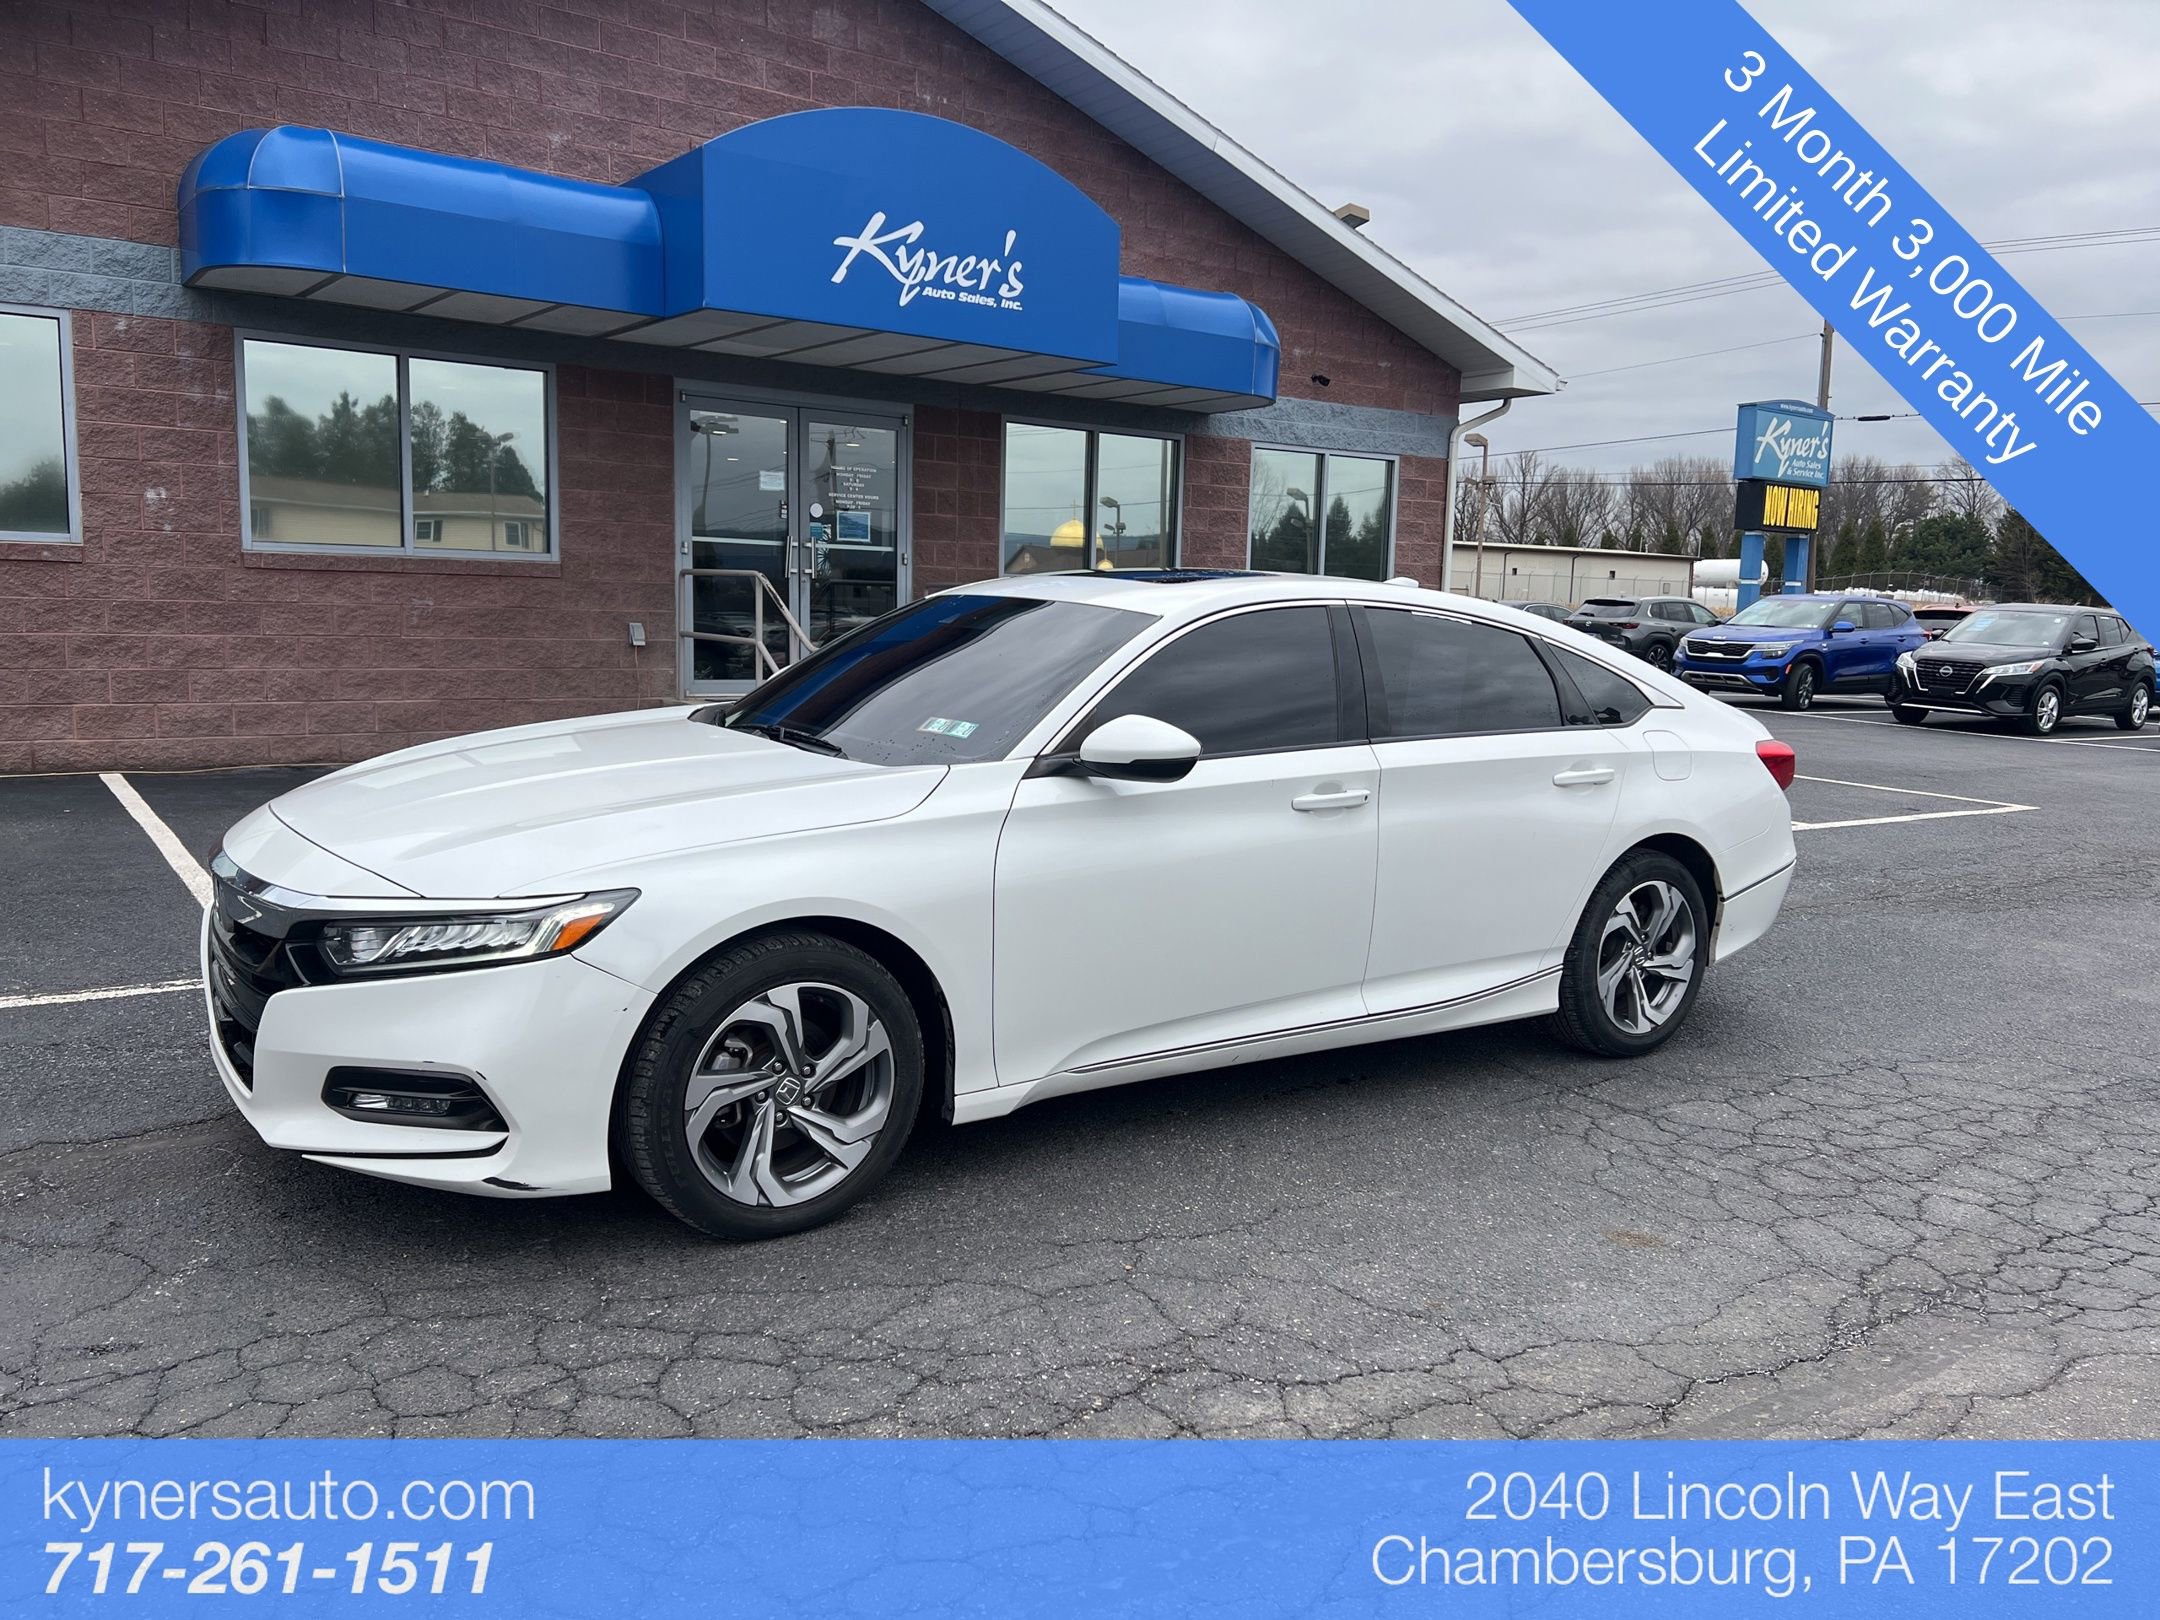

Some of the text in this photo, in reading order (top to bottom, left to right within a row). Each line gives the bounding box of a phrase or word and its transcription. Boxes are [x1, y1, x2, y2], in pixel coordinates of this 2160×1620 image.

[830, 210, 1024, 307] Kyner's
[921, 285, 1024, 312] Auto Sales, Inc.
[1754, 417, 1829, 478] Kyner's
[1791, 458, 1822, 470] Auto Sales
[1792, 467, 1814, 478] Service
[1763, 484, 1820, 530] NOW HIRING
